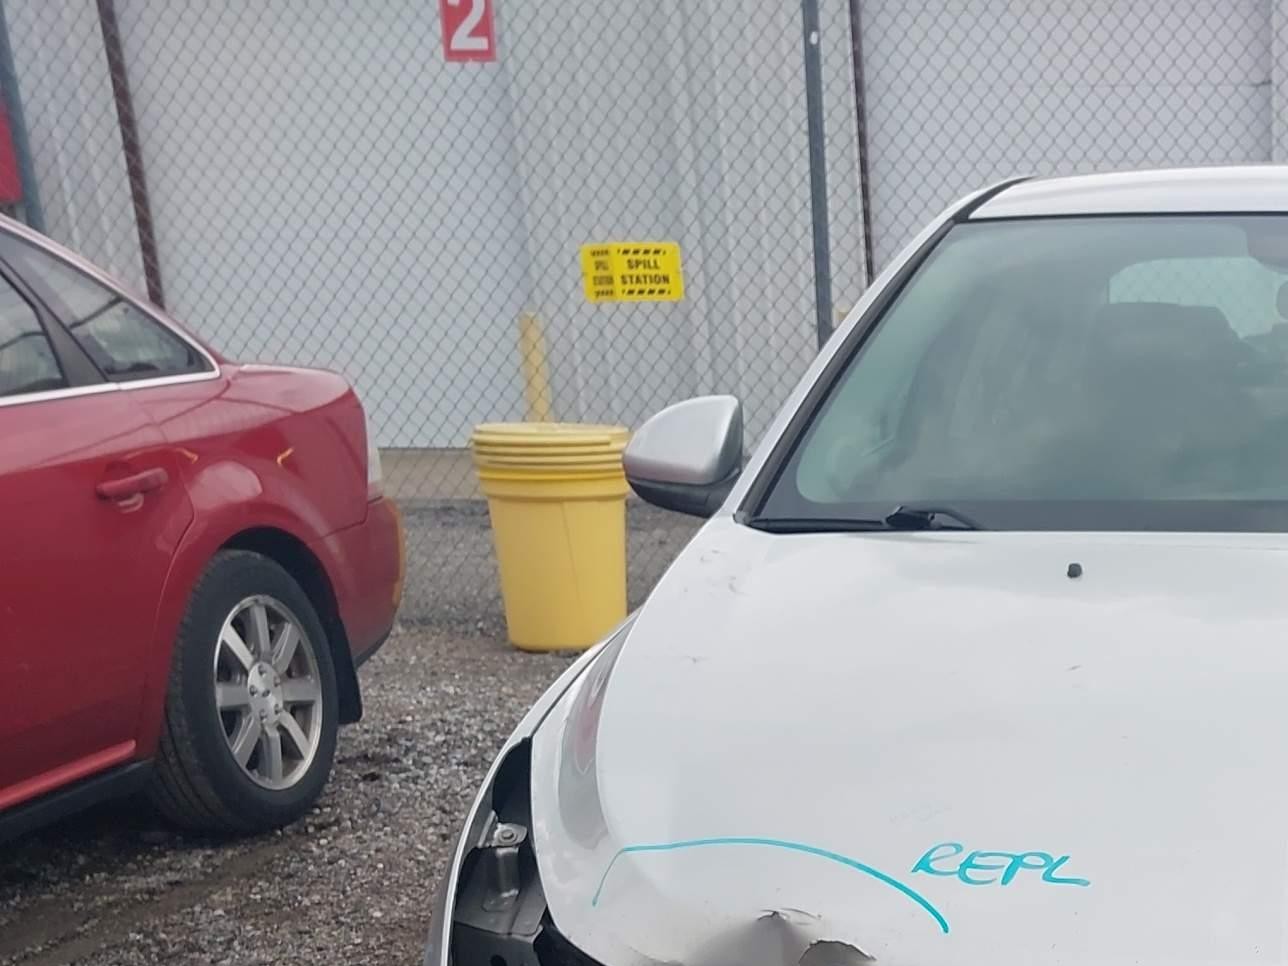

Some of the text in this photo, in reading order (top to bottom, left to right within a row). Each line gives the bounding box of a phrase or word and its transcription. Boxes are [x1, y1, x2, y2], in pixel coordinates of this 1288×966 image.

[447, 0, 488, 50] 2
[627, 259, 660, 270] SPILL
[620, 274, 670, 285] STATION
[911, 842, 1090, 887] REPL
